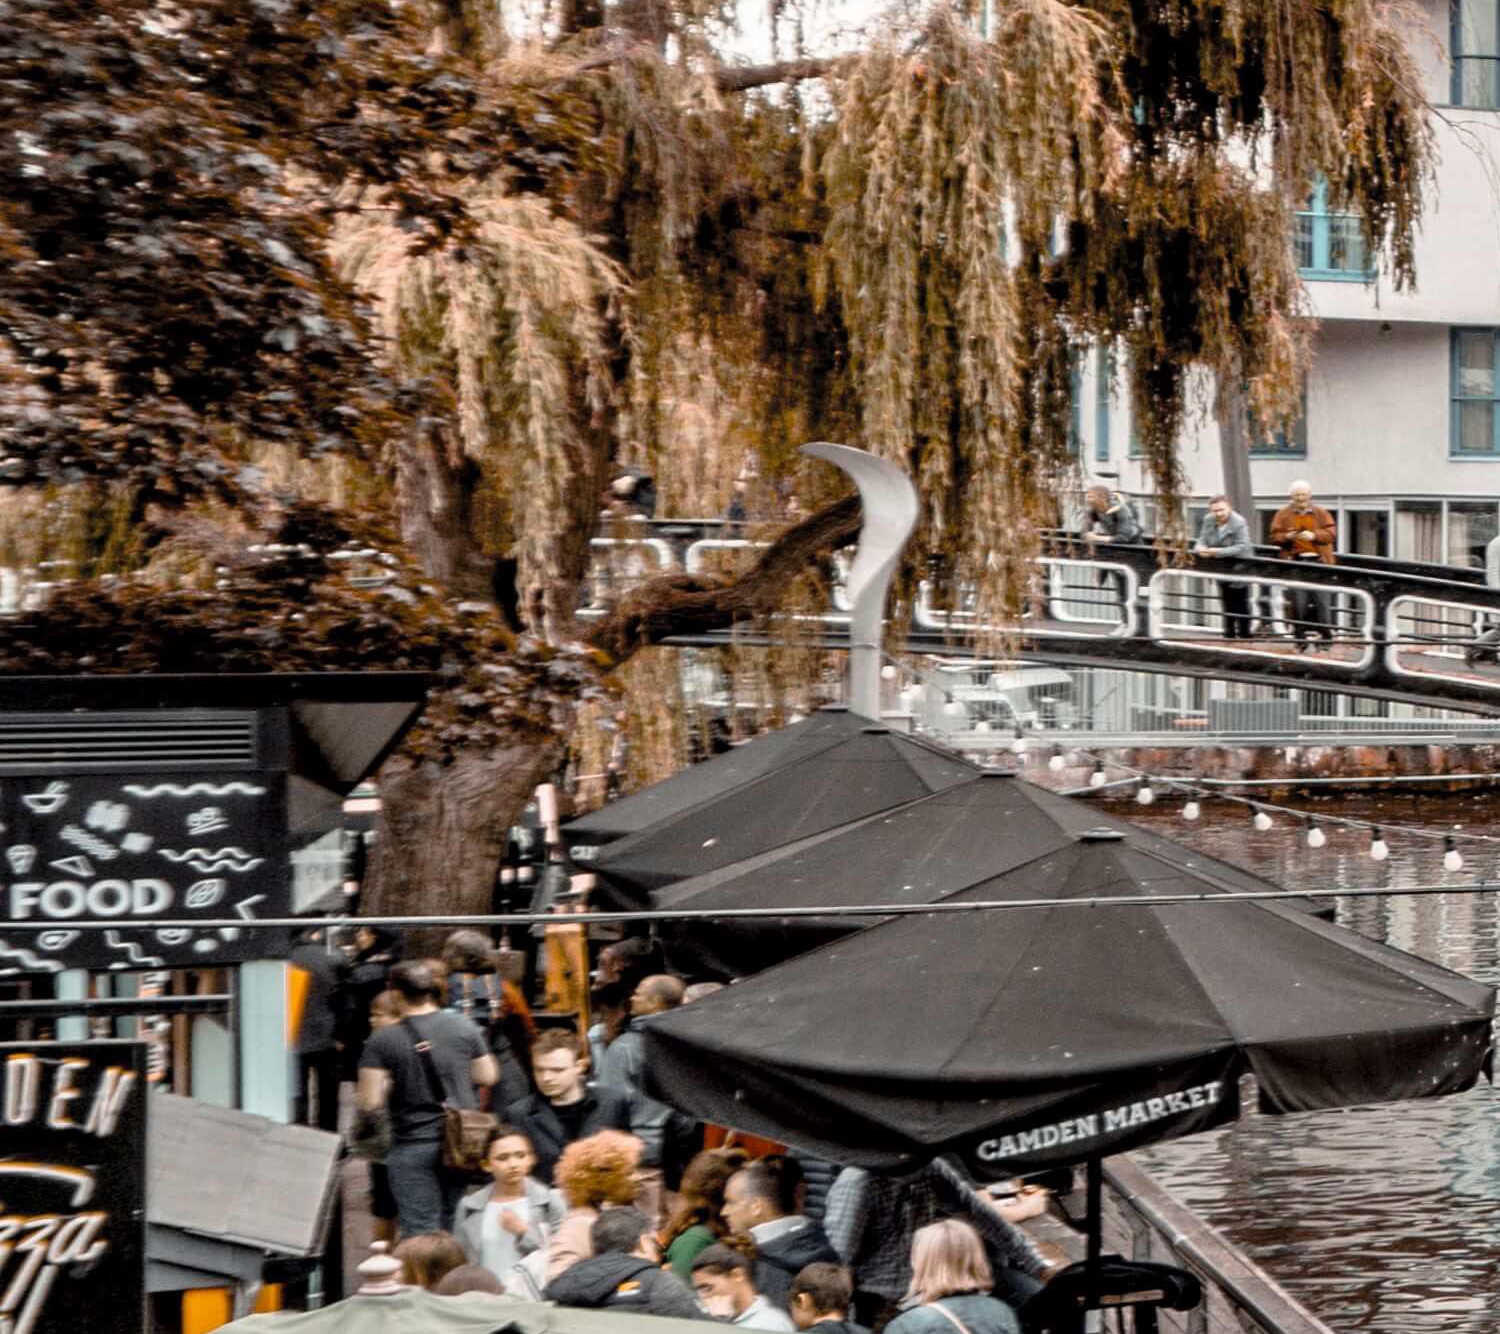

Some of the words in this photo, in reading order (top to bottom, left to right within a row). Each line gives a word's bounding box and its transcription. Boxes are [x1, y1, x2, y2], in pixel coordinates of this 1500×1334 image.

[9, 878, 173, 919] FOOD
[977, 1115, 1099, 1161] CAMDEN
[1104, 1080, 1223, 1132] MARKET
